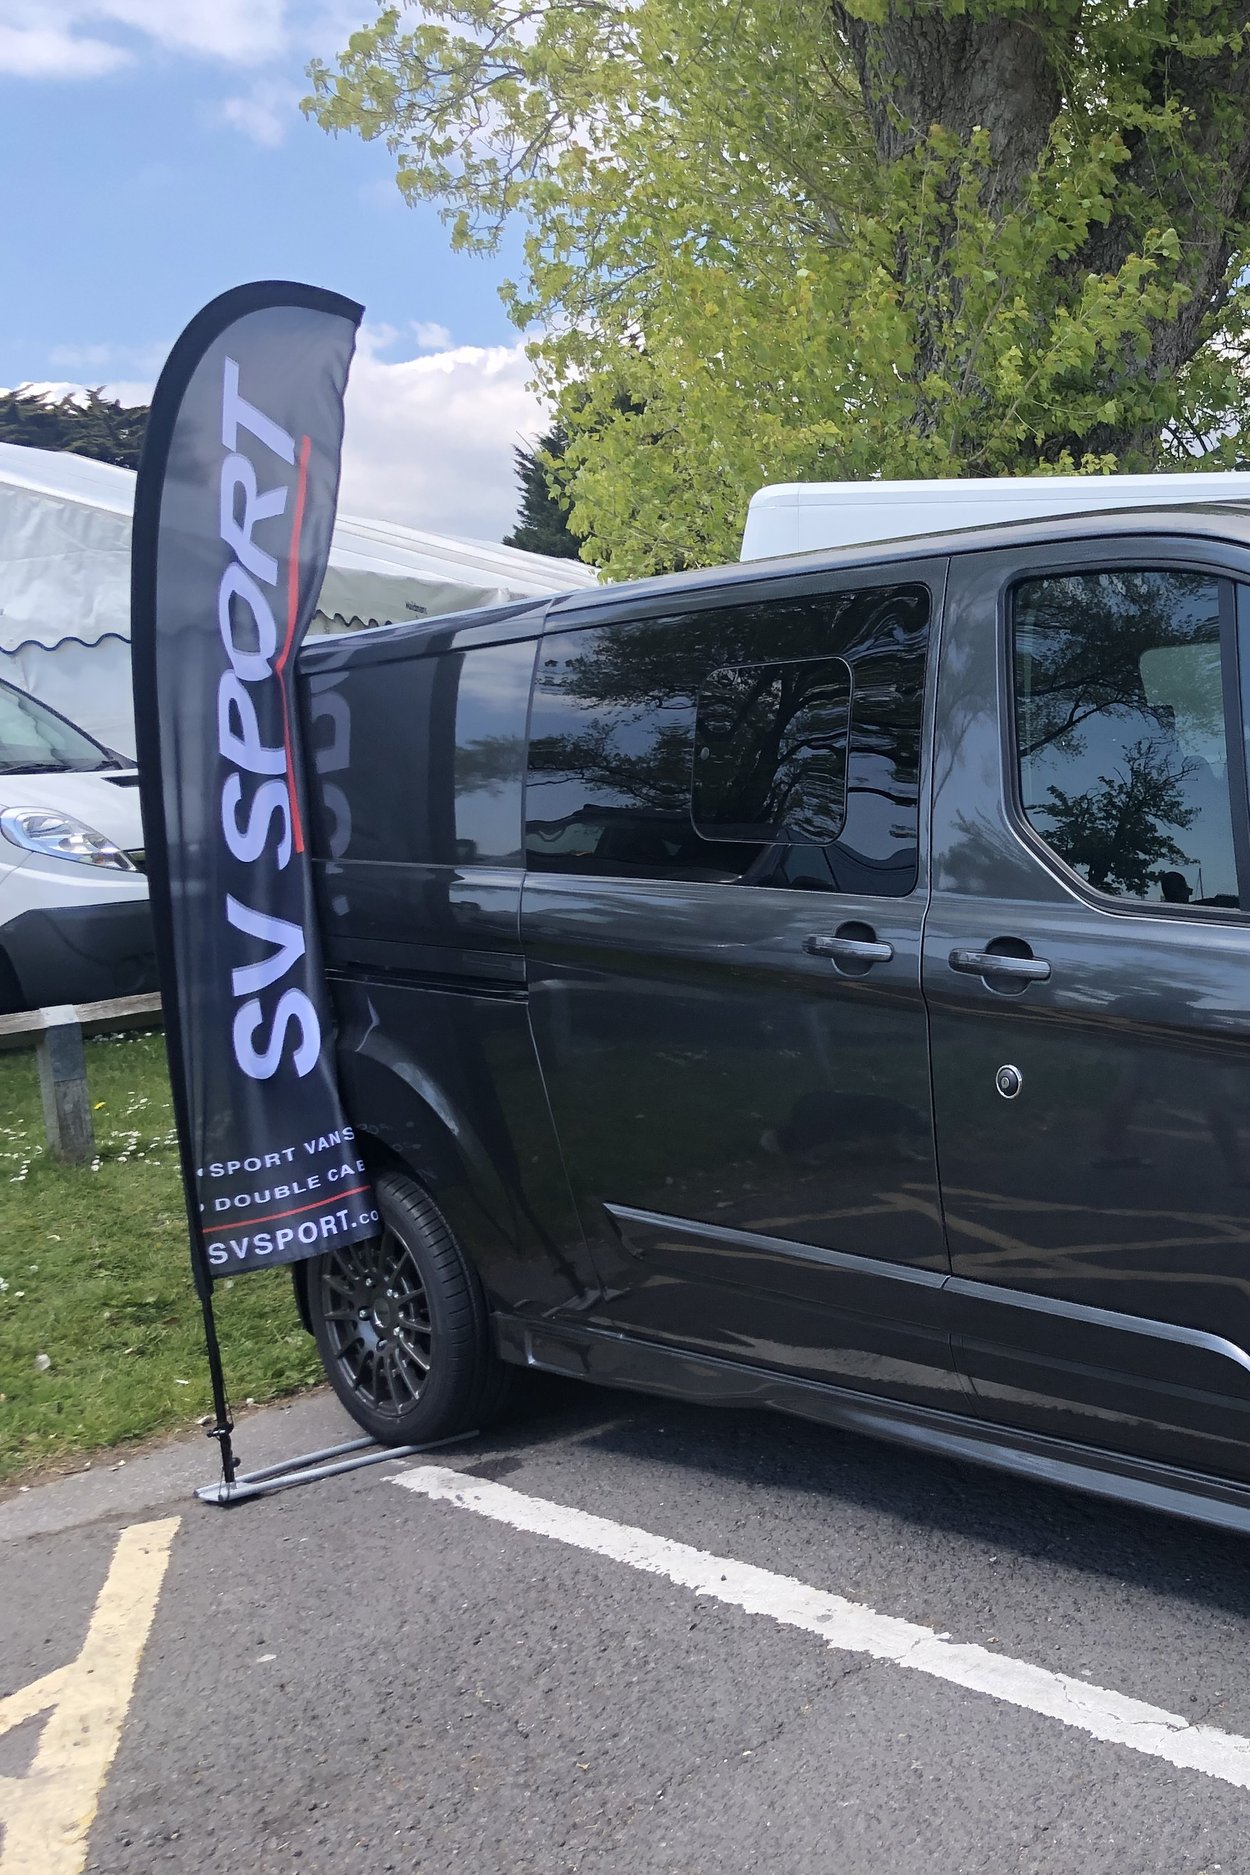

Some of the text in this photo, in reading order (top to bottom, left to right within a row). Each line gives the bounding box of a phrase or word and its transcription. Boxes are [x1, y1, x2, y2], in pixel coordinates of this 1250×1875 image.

[218, 355, 321, 1080] SV SPORT
[209, 1147, 295, 1177] SPORT
[303, 1127, 355, 1155] VANS
[215, 1175, 321, 1212] DOUBLE
